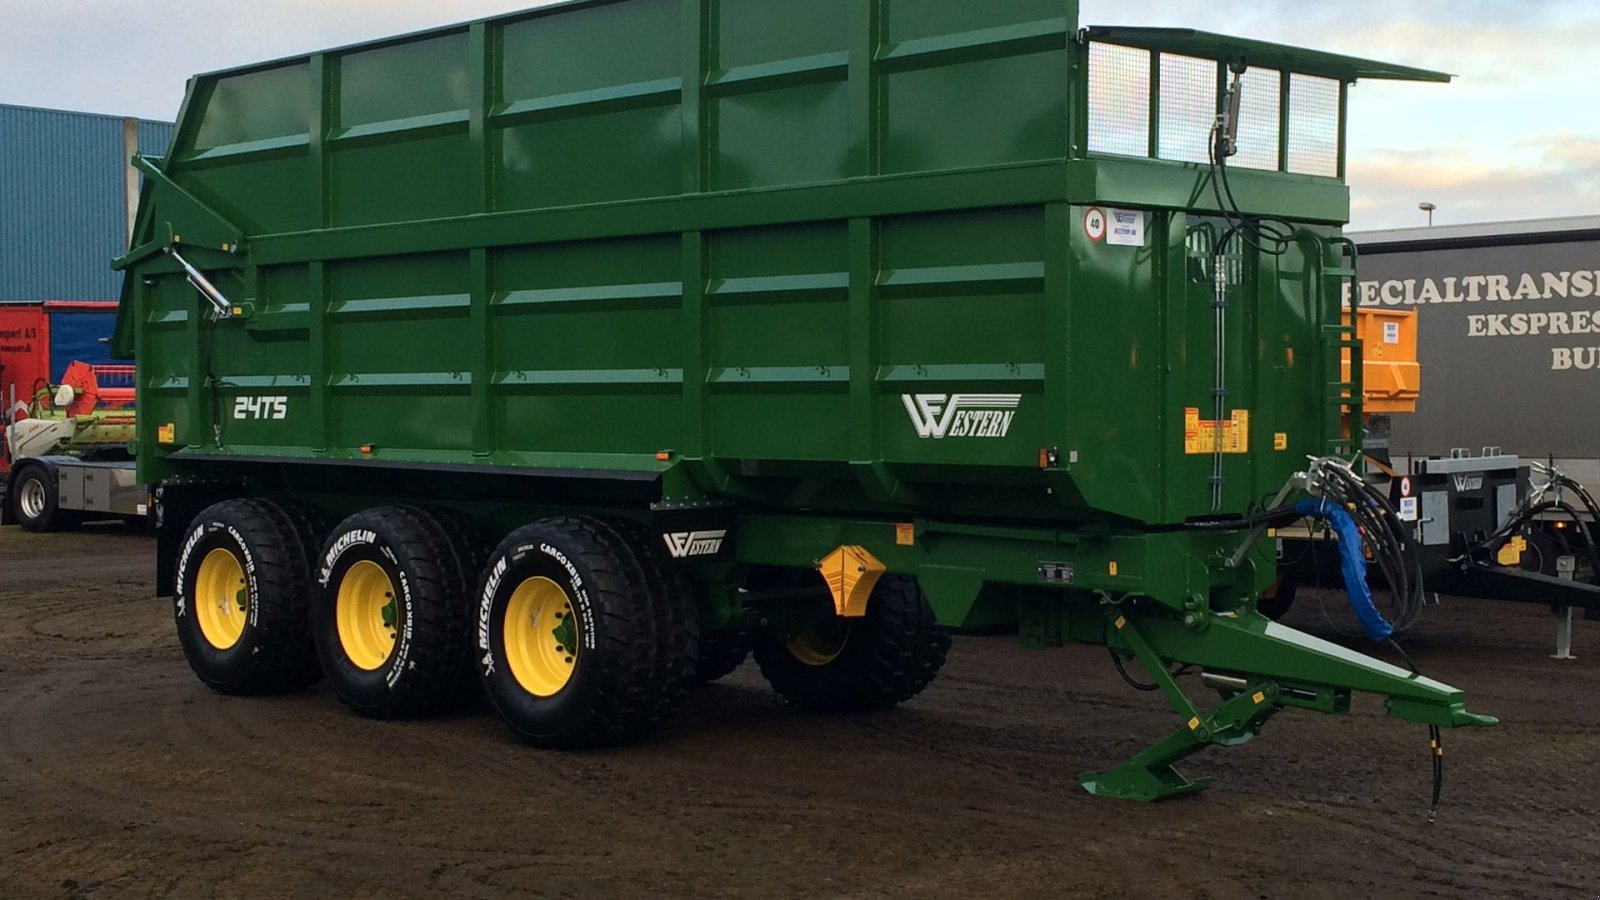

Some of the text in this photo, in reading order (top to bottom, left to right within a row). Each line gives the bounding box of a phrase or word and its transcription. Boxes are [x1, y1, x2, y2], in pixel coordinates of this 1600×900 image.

[1090, 218, 1100, 229] 40
[1551, 346, 1600, 370] BU
[234, 396, 288, 419] 24TS
[901, 393, 1022, 438] WESTERN
[177, 524, 204, 595] MICHELIN
[326, 529, 376, 567] MICHELIN
[479, 555, 506, 650] MICHELIN
